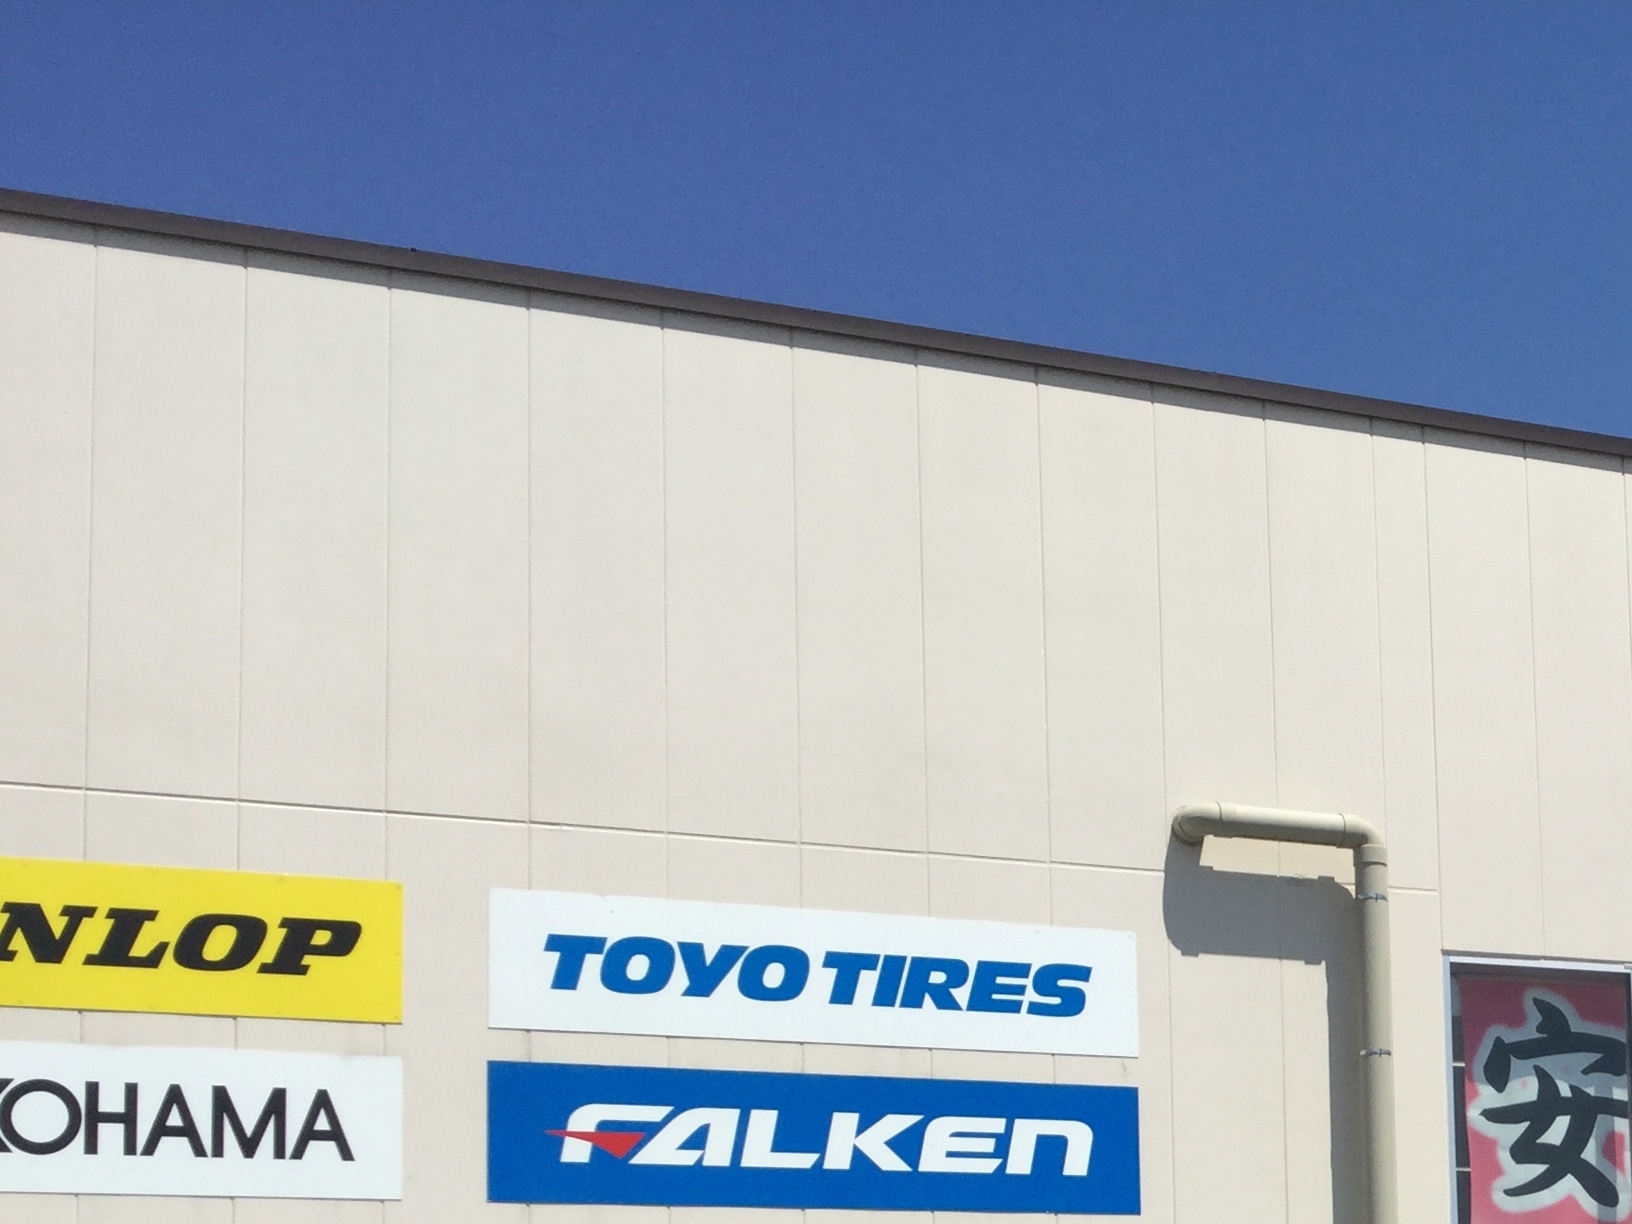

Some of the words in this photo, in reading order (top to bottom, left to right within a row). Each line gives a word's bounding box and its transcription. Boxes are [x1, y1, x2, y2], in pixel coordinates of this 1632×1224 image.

[543, 933, 811, 1002] TOYO
[822, 951, 1094, 1018] TIRES
[0, 1077, 356, 1162] OHAMA
[544, 1103, 1094, 1177] FALKEN
